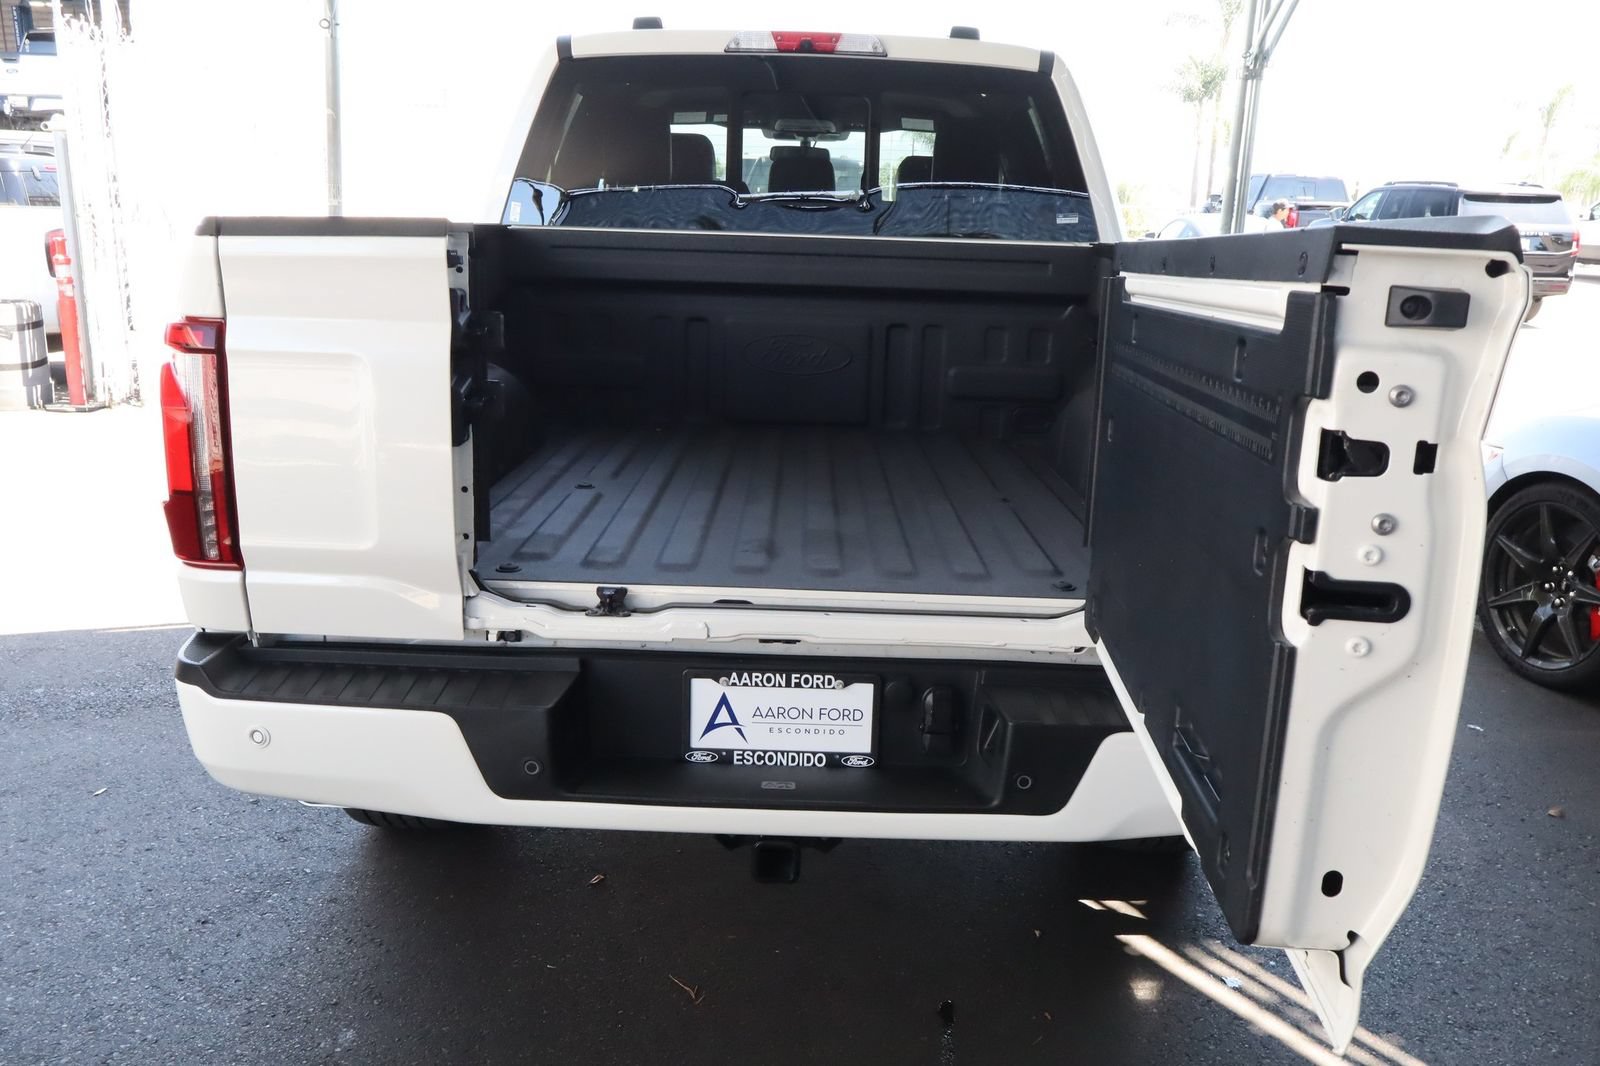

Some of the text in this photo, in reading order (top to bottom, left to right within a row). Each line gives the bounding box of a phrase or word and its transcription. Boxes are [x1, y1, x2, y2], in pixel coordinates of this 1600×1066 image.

[729, 672, 836, 689] AARON FORD
[752, 706, 864, 722] AARON FORD
[769, 727, 845, 736] ESCONDIDO
[690, 751, 713, 761] Ford
[733, 750, 827, 767] ESCONDIDO
[847, 756, 869, 766] Ford
